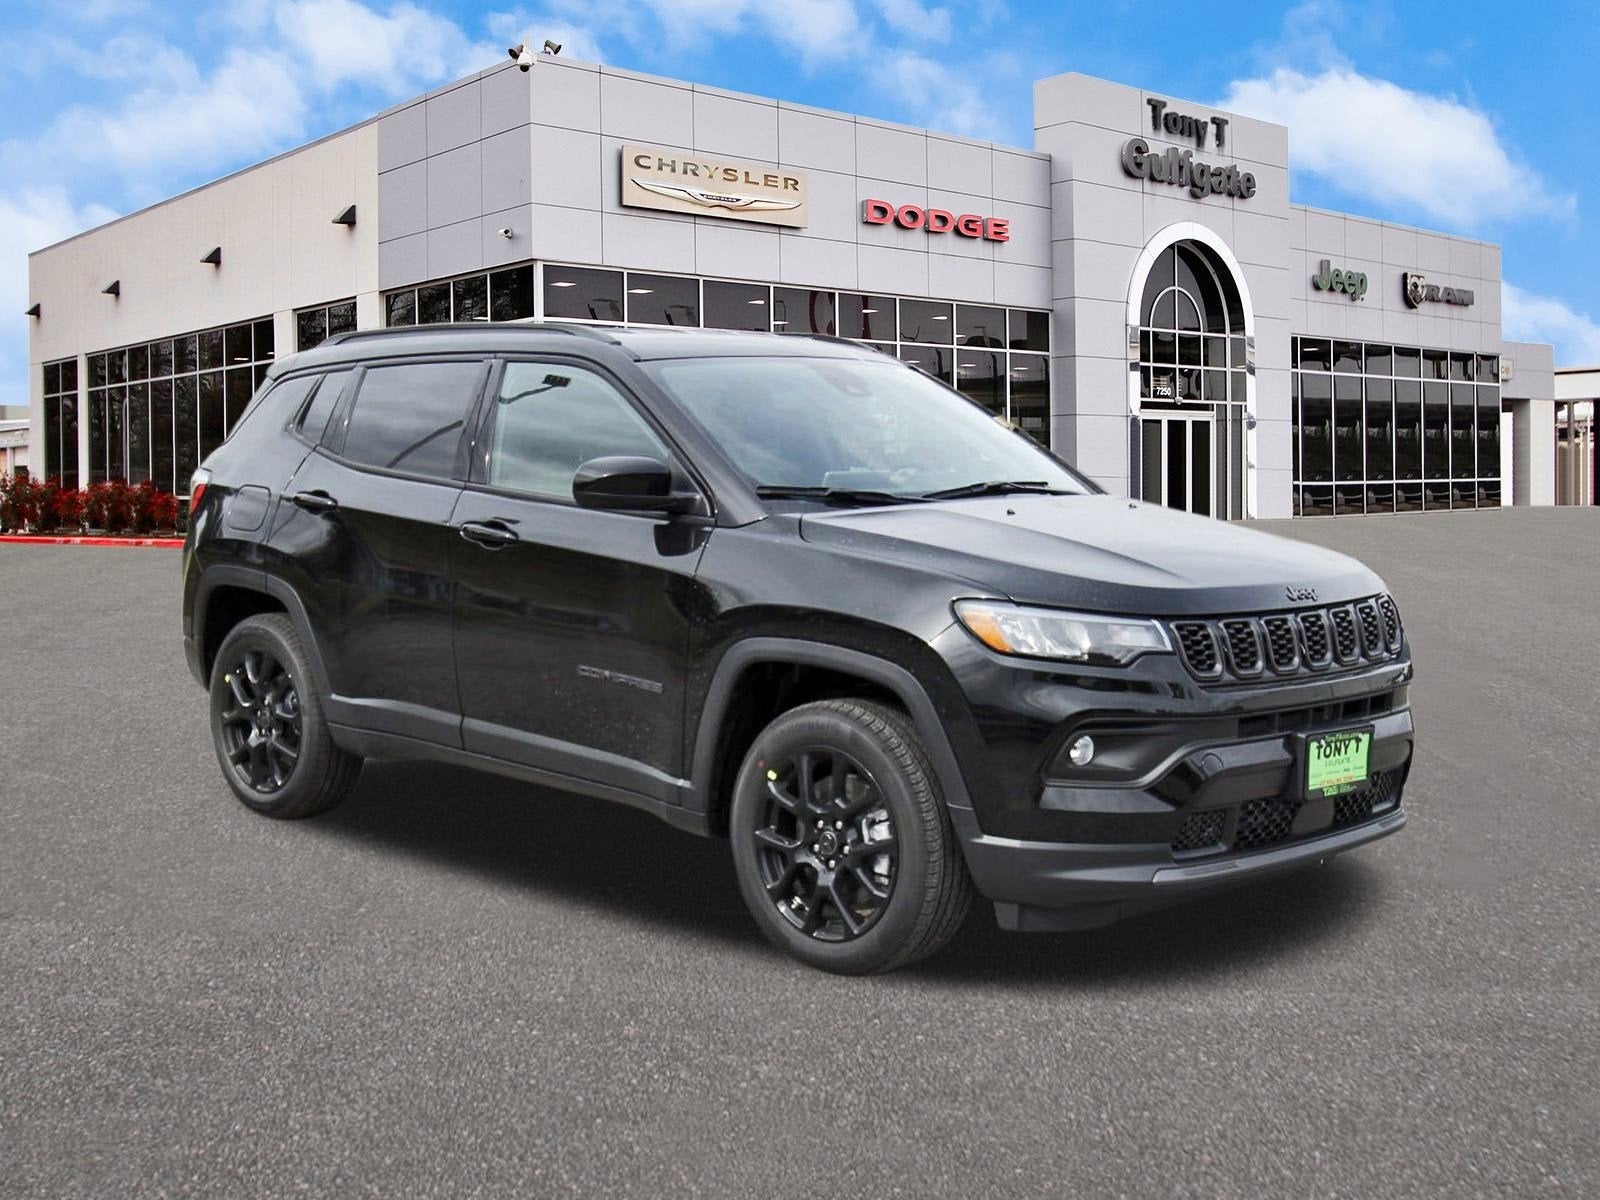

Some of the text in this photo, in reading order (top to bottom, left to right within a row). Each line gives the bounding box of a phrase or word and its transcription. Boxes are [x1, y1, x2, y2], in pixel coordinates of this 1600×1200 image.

[1146, 98, 1229, 148] Tony T
[634, 154, 800, 192] CHRYSLER
[1120, 138, 1257, 199] Gulfgate
[861, 199, 1010, 243] DODGE
[1312, 259, 1369, 302] Jeep
[1424, 284, 1475, 307] RAM
[1156, 386, 1172, 396] 7250
[1316, 739, 1351, 760] TONY
